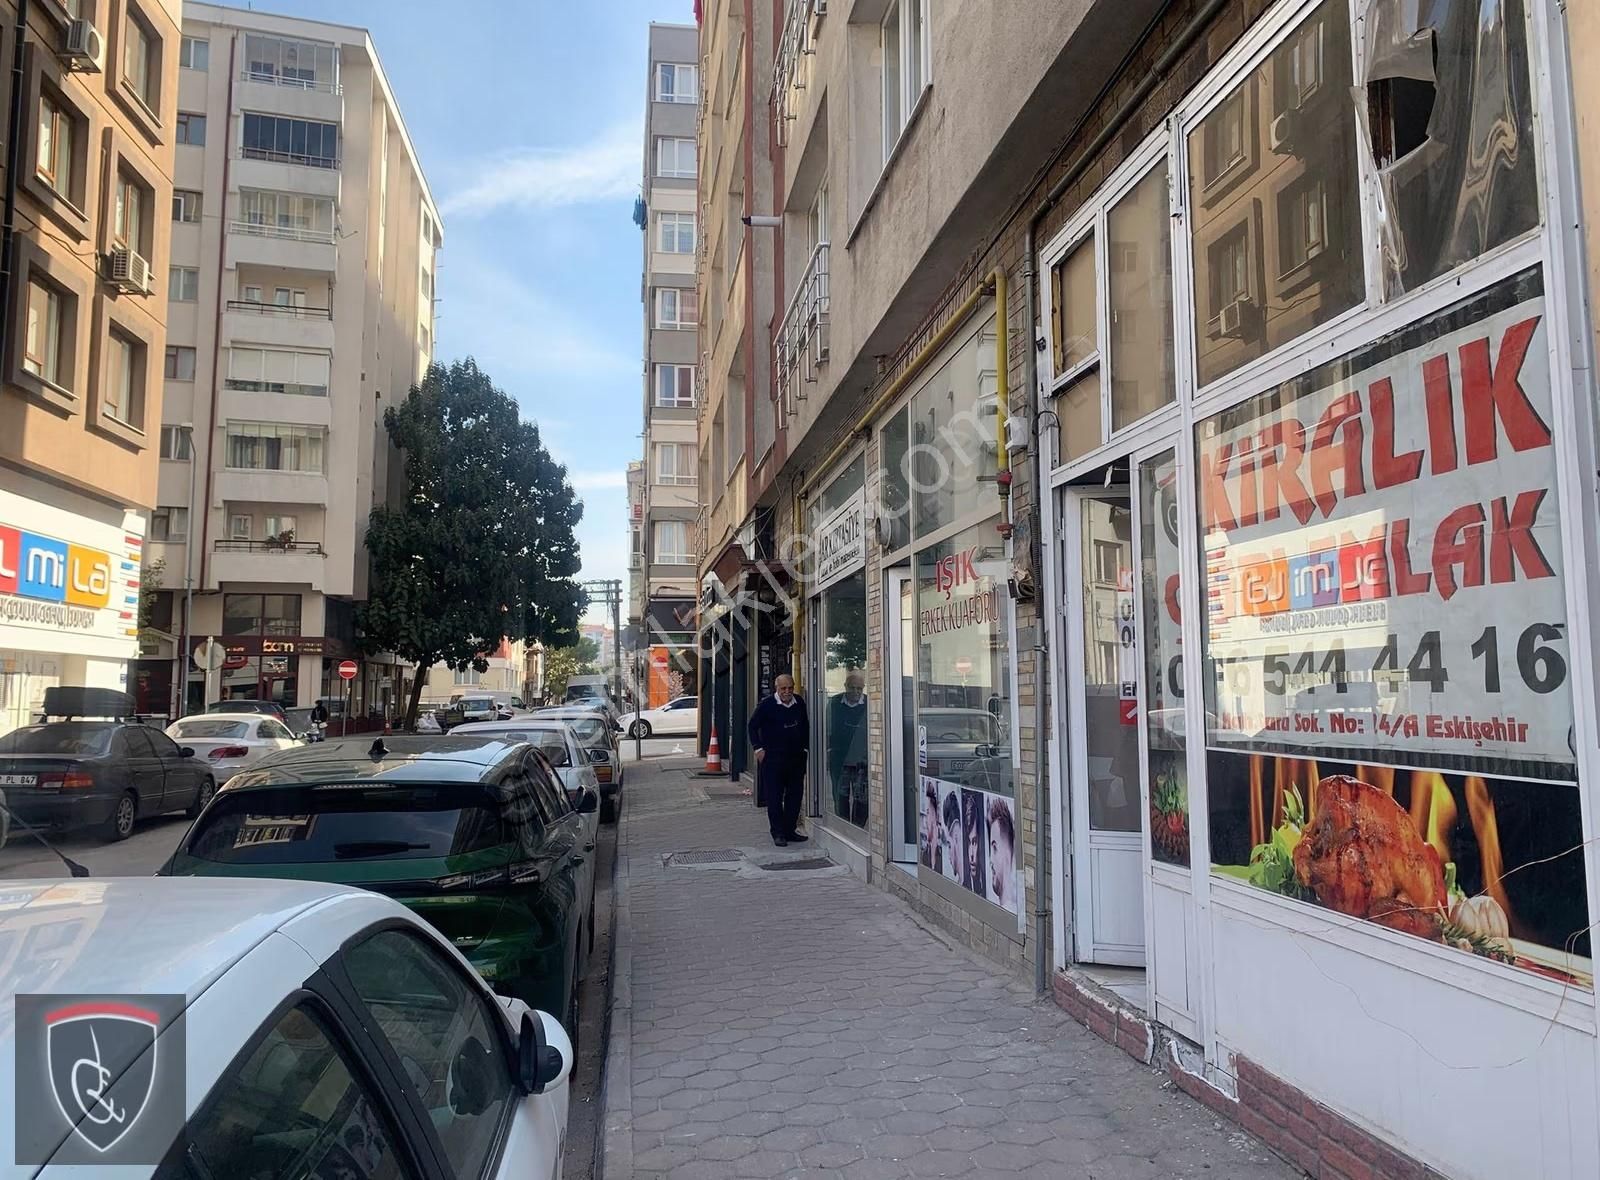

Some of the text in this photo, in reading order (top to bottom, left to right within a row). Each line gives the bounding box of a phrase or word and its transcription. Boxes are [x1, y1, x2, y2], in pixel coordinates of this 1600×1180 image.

[935, 545, 980, 600] IŞIK
[921, 582, 1000, 636] ERKEK KUAFÖRÜ
[1372, 630, 1449, 693] 44
[1471, 622, 1567, 694] 16
[1294, 713, 1325, 733] Sok.
[1330, 713, 1365, 733] No:
[1425, 715, 1529, 747] Eskişehir
